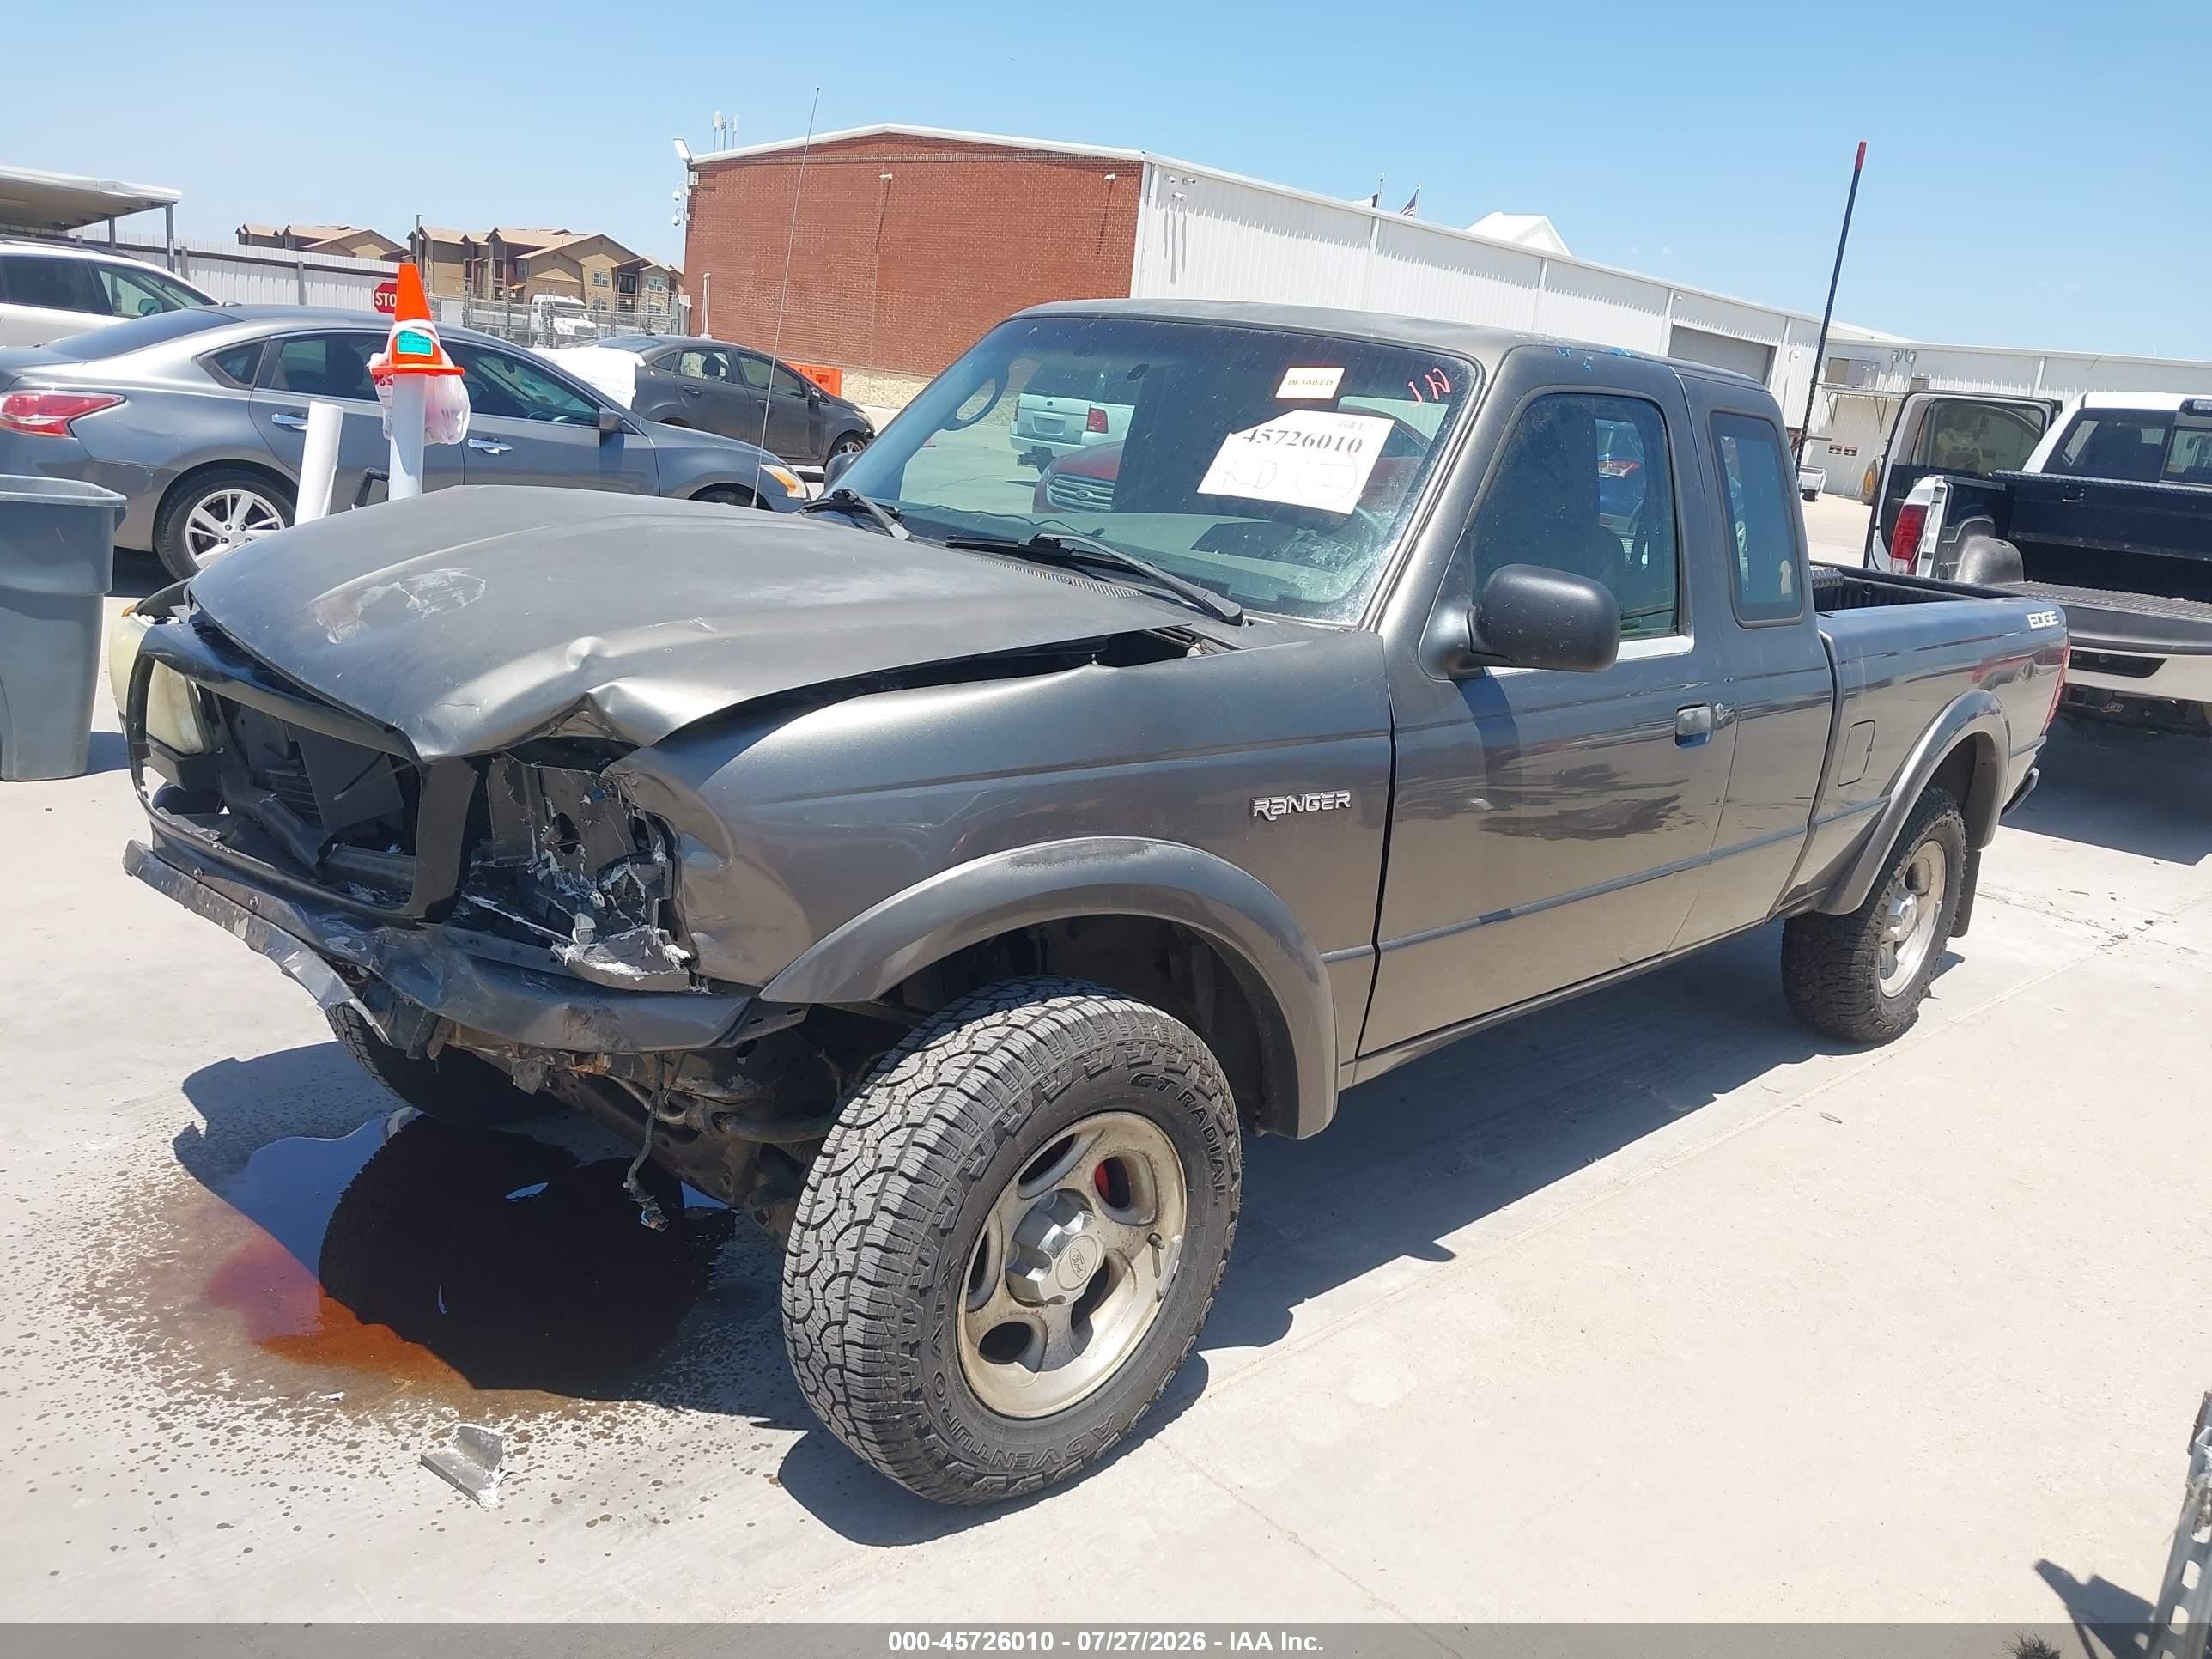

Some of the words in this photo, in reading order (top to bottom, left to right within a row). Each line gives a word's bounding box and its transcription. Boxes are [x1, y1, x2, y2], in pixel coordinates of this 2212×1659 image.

[375, 292, 396, 307] STO
[1243, 428, 1363, 454] 45726010
[2027, 611, 2059, 629] EDGE
[1251, 790, 1351, 821] RANGER
[1128, 1072, 1179, 1092] GT
[1176, 1087, 1226, 1206] RADIAL
[1071, 1254, 1084, 1275] Ford
